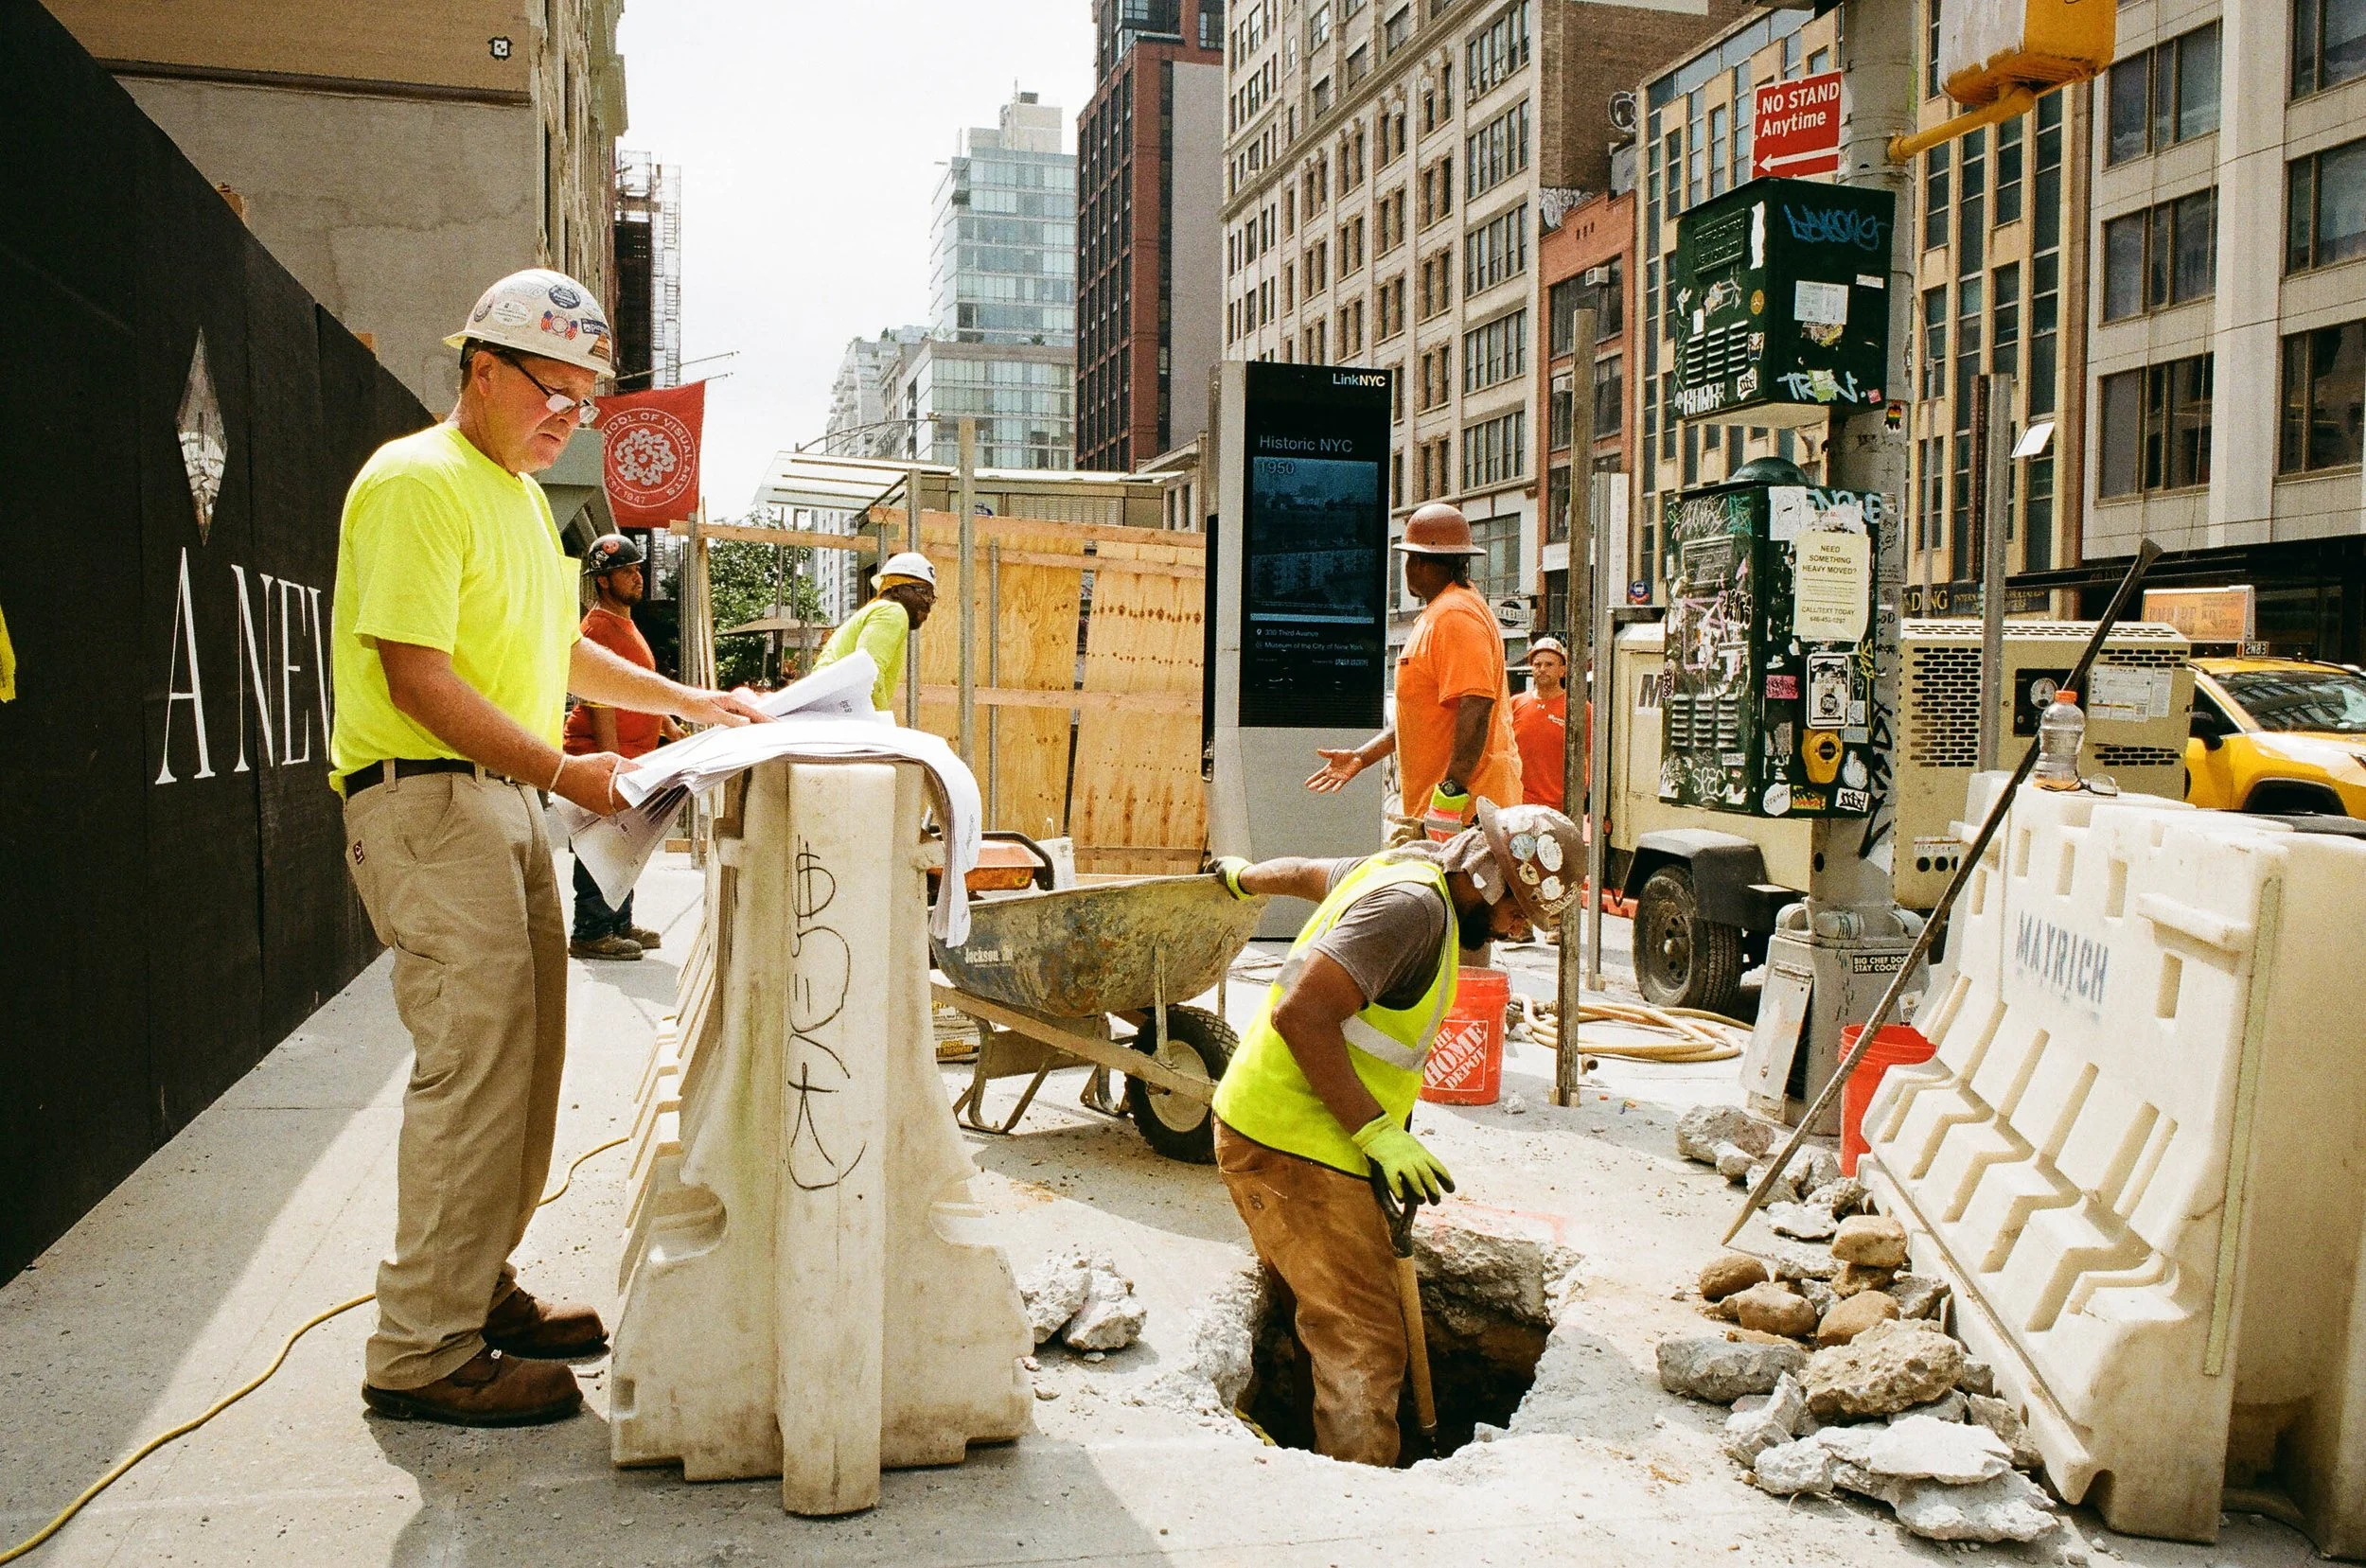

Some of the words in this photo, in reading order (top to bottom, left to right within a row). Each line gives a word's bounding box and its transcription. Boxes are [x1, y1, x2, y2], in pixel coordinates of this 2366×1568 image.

[1761, 94, 1784, 115] NO
[1788, 81, 1840, 110] STAND
[1761, 111, 1827, 137] Anytime
[1333, 373, 1386, 387] LinkNYC
[640, 412, 660, 422] OF
[663, 417, 693, 462] VISUAL
[1260, 435, 1315, 450] Historic
[1319, 438, 1353, 452] NYC
[1261, 462, 1295, 475] 1950
[667, 466, 691, 497] ARTS
[623, 490, 646, 504] 1947
[1820, 545, 1841, 554] NEED
[1809, 555, 1852, 564] SOMETHING
[1802, 564, 1826, 573] HEAVY
[1827, 566, 1858, 575] MOVED?
[1264, 641, 1293, 649] Museum
[1313, 643, 1325, 651] City
[2245, 643, 2267, 655] 2N83
[155, 547, 216, 785] A
[1869, 956, 1889, 964] CHEF
[2015, 909, 2110, 1005] MAYRICH
[1430, 1027, 1456, 1054] THE
[1424, 1021, 1486, 1087] HOME
[1443, 1047, 1485, 1090] DEPOT
